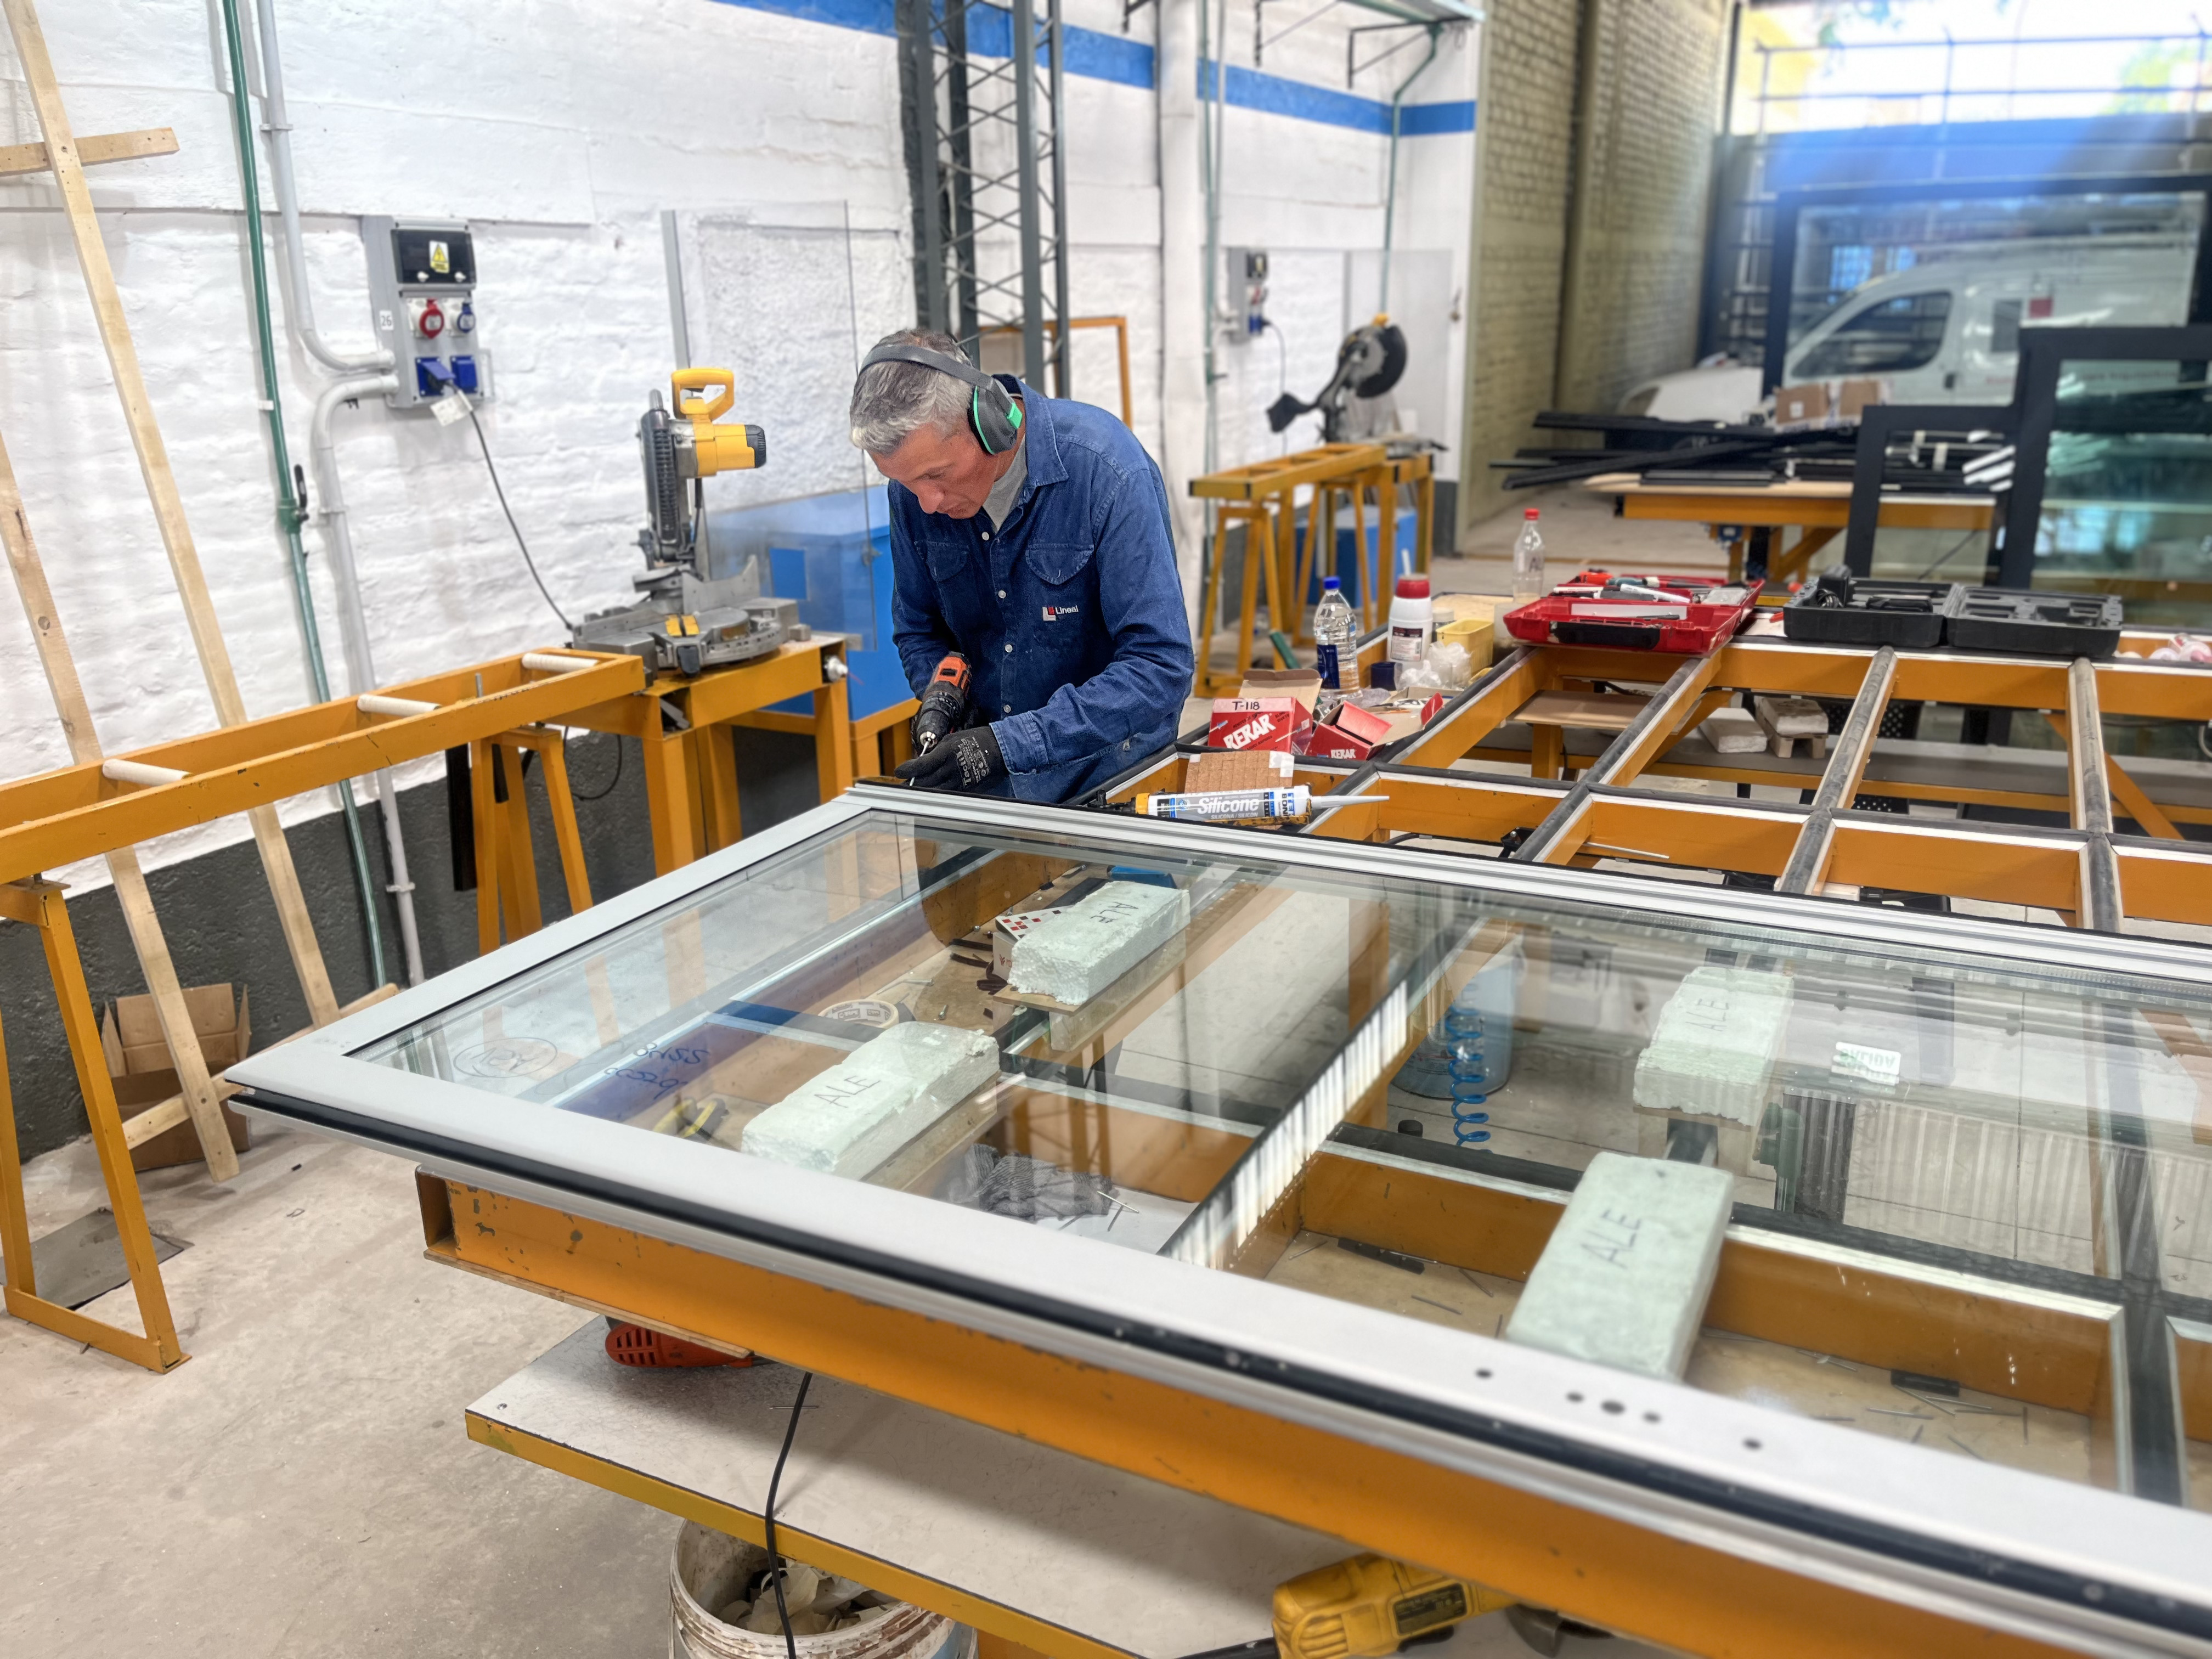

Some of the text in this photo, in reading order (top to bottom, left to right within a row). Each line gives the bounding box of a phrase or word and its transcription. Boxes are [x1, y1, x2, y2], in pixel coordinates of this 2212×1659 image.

[381, 315, 392, 326] 26
[1232, 701, 1260, 710] T-118
[1197, 797, 1260, 815] Silicone
[1685, 997, 1730, 1032] ALE
[814, 1075, 882, 1108] ALE
[1581, 1209, 1641, 1269] ALE
